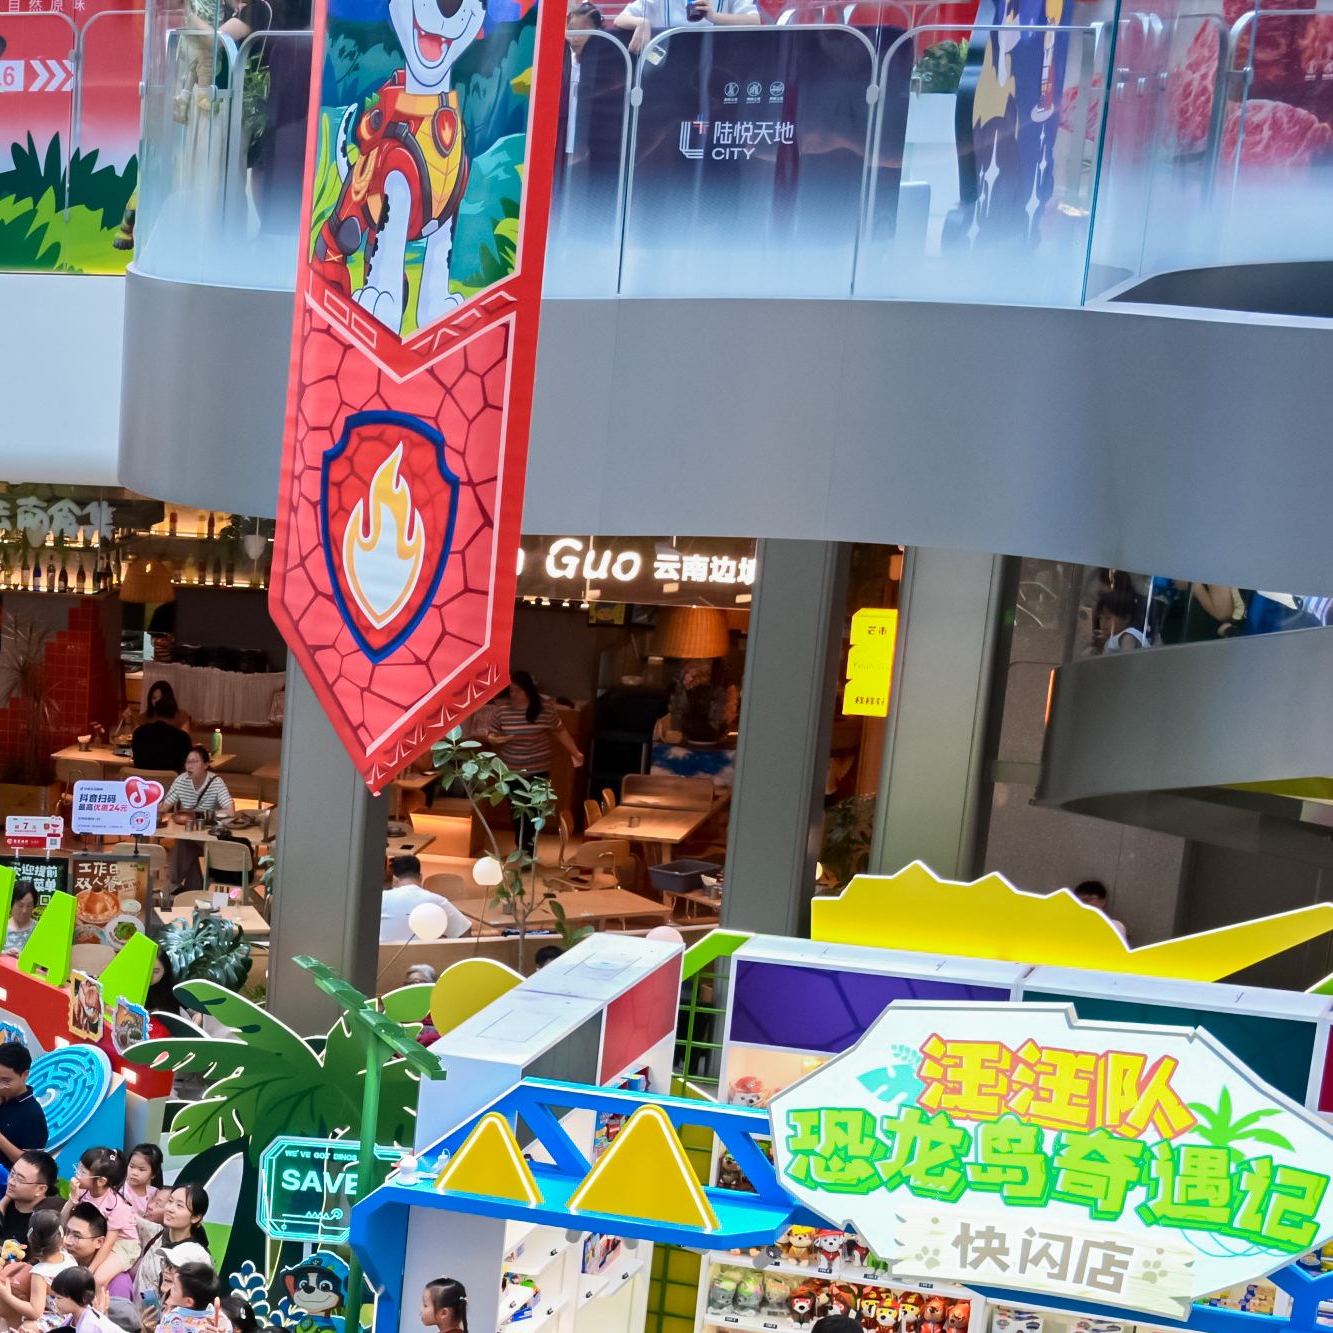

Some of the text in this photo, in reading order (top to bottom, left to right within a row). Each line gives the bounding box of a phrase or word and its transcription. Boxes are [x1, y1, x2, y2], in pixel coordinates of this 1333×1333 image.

[713, 121, 795, 145] 陆悦天地
[711, 147, 756, 161] CITY
[79, 793, 117, 804] 抖音扫码
[918, 1032, 1198, 1141] 汪汪队
[284, 1149, 358, 1162] WE'VE GOT DINOS
[281, 1168, 359, 1196] SAVE
[785, 1105, 1332, 1256] 恐龙岛奇遇记
[952, 1222, 1134, 1295] 快闪店
